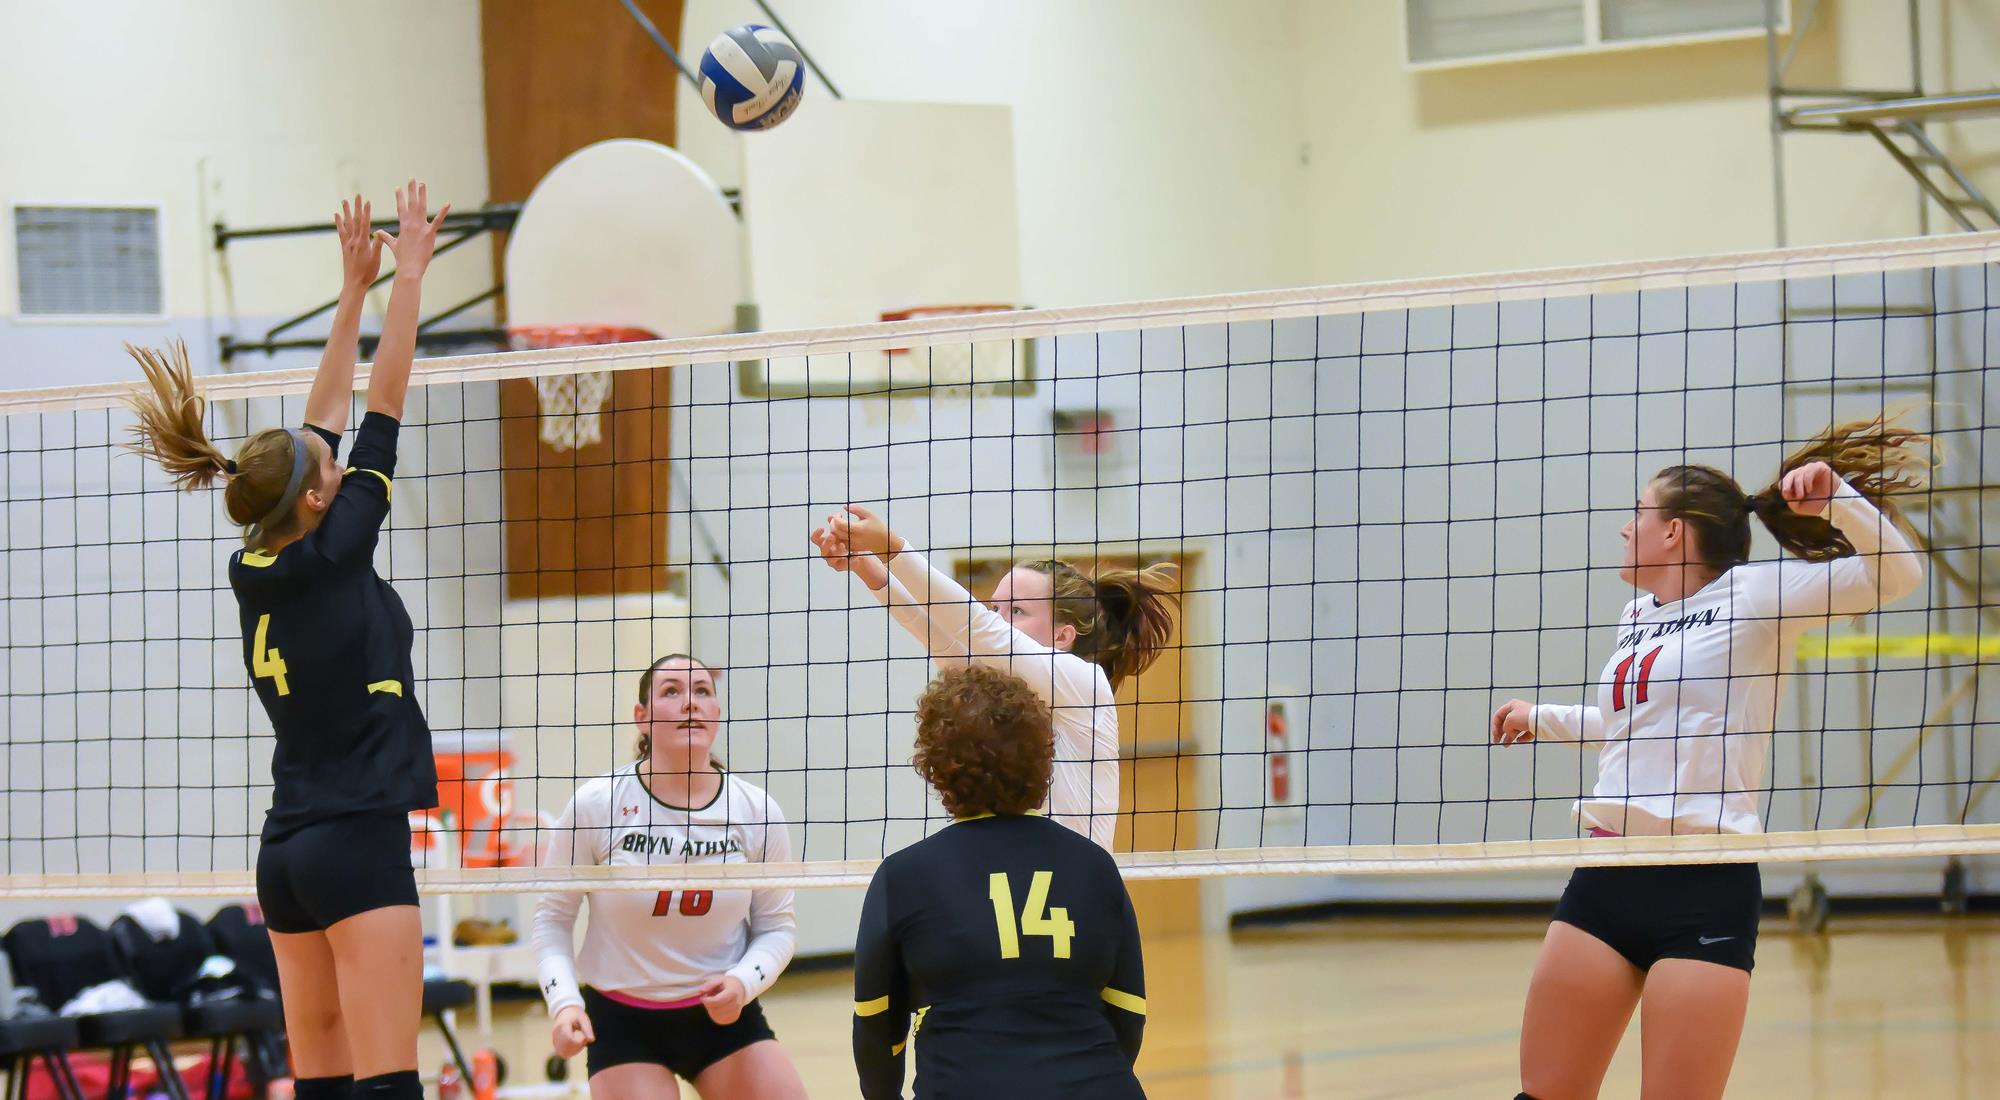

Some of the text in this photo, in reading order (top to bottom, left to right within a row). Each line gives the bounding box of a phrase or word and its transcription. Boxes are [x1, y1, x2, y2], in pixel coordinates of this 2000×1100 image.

[252, 613, 290, 696] 4
[1650, 606, 1721, 640] ATHYN
[1612, 644, 1664, 712] 11
[622, 833, 674, 856] BRYN
[989, 870, 1076, 960] 14
